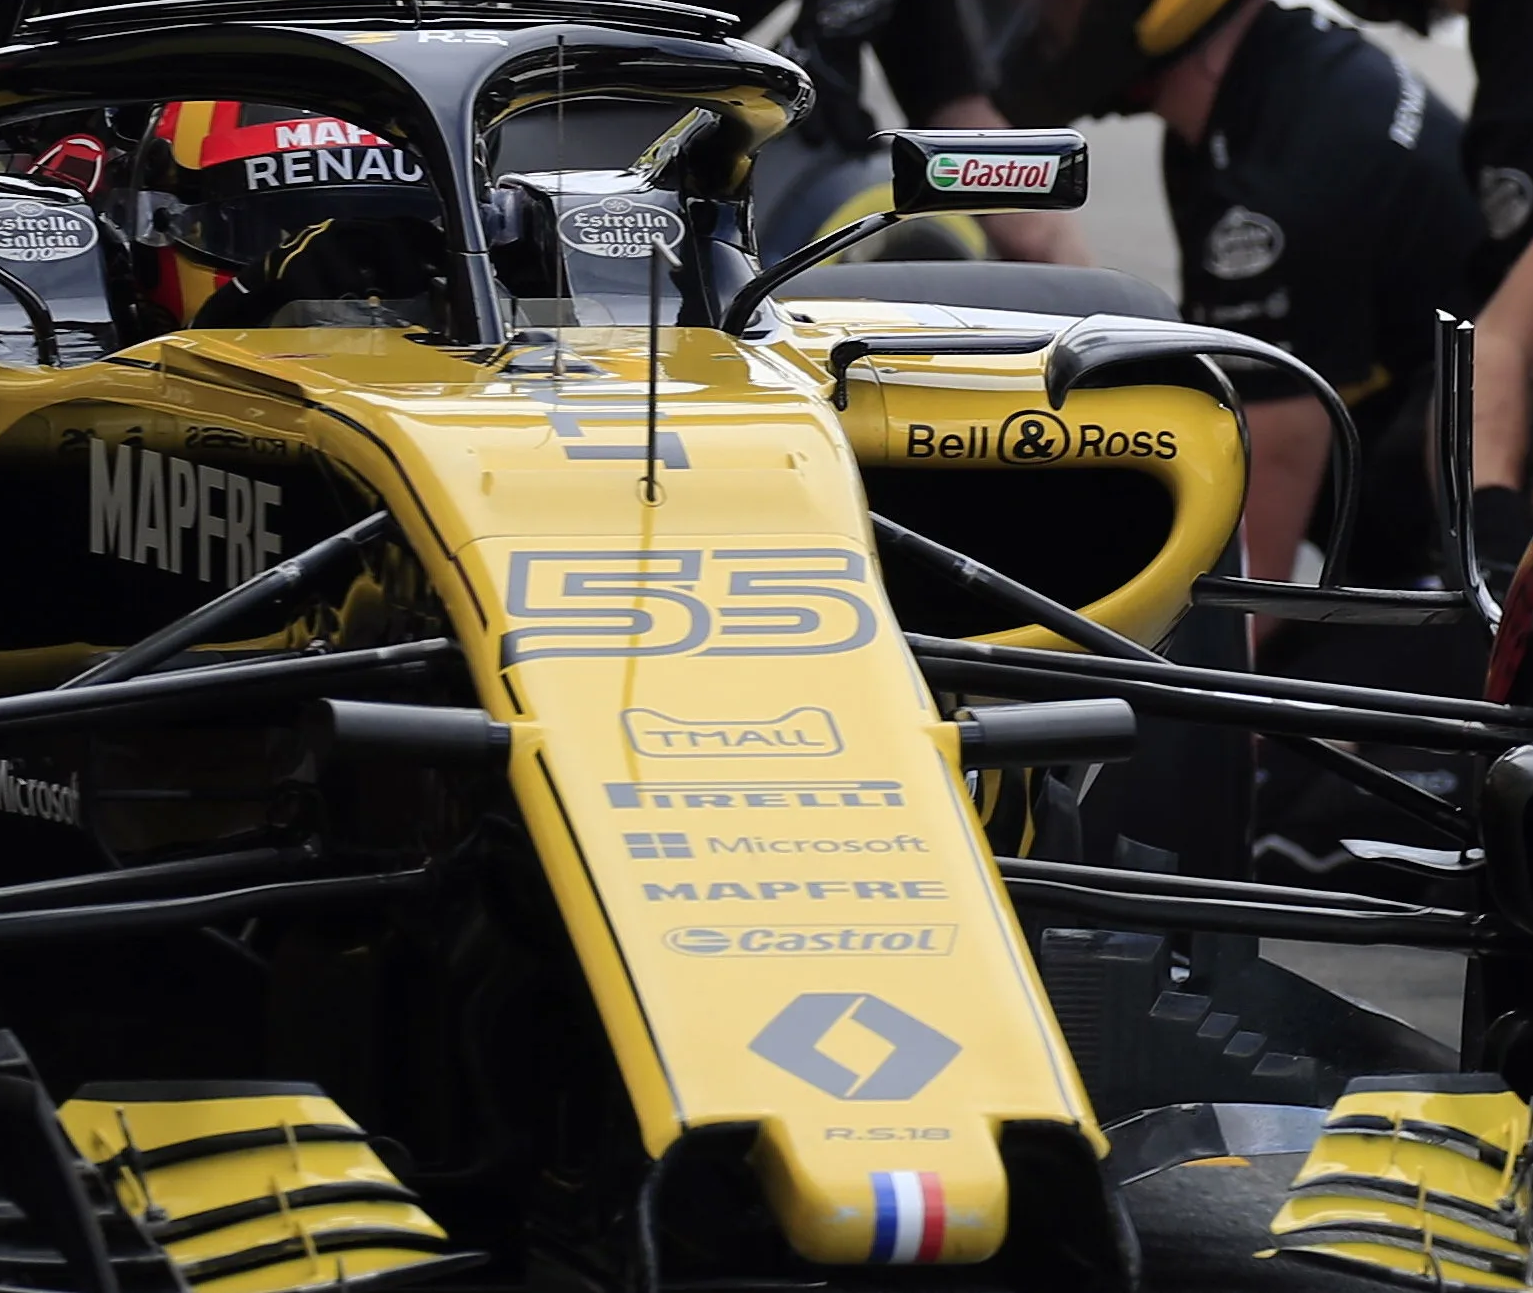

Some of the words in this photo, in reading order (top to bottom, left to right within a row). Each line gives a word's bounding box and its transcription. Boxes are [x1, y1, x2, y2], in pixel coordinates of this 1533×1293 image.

[961, 157, 1050, 189] Castrol
[573, 211, 669, 229] Estrella
[579, 227, 666, 246] Galicia
[906, 424, 989, 459] Bell
[1005, 413, 1063, 462] &
[1077, 423, 1179, 459] Ross
[90, 437, 283, 588] MAPFRE
[501, 548, 877, 669] 55
[644, 729, 826, 748] TMALL
[603, 780, 905, 808] PIRELLI
[706, 834, 931, 855] Microsoft
[642, 880, 950, 902] MAPFRE
[739, 927, 937, 952] Castrol
[824, 1125, 953, 1142] R.S.18
